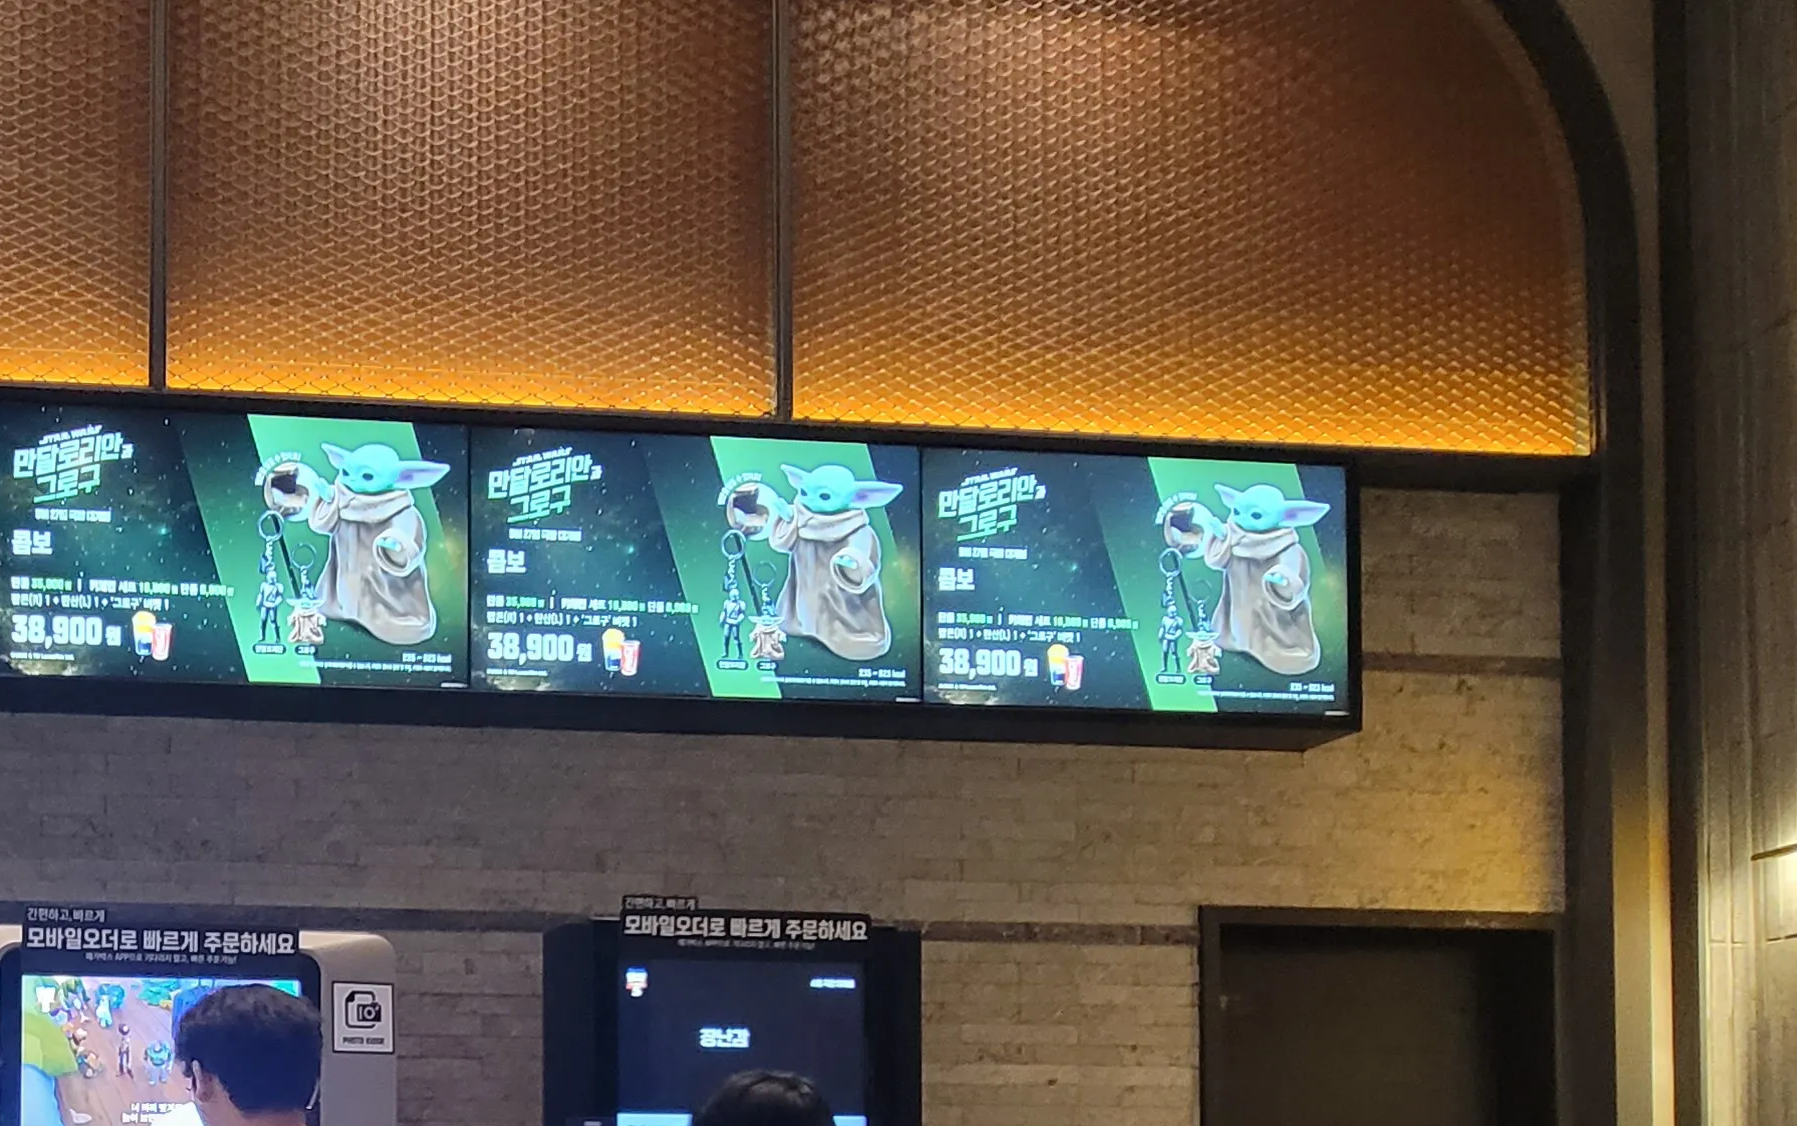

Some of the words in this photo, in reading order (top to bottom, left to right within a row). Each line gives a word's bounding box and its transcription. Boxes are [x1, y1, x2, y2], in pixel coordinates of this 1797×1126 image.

[33, 463, 101, 504] 그로구
[507, 484, 571, 523] 그로구
[957, 504, 1017, 542] 그로구
[11, 614, 103, 649] 38,900
[487, 632, 574, 665] 38,900
[939, 648, 1021, 680] 38,900
[26, 927, 138, 950] 모바일오더로
[143, 930, 198, 952] 빠르게
[204, 931, 295, 955] 주문하세요
[624, 915, 726, 937] 모바일오더로
[730, 917, 781, 938] 빠르게
[785, 919, 868, 941] 주문하세요
[343, 1037, 364, 1045] PHOTO
[699, 1028, 750, 1048] 장난감
